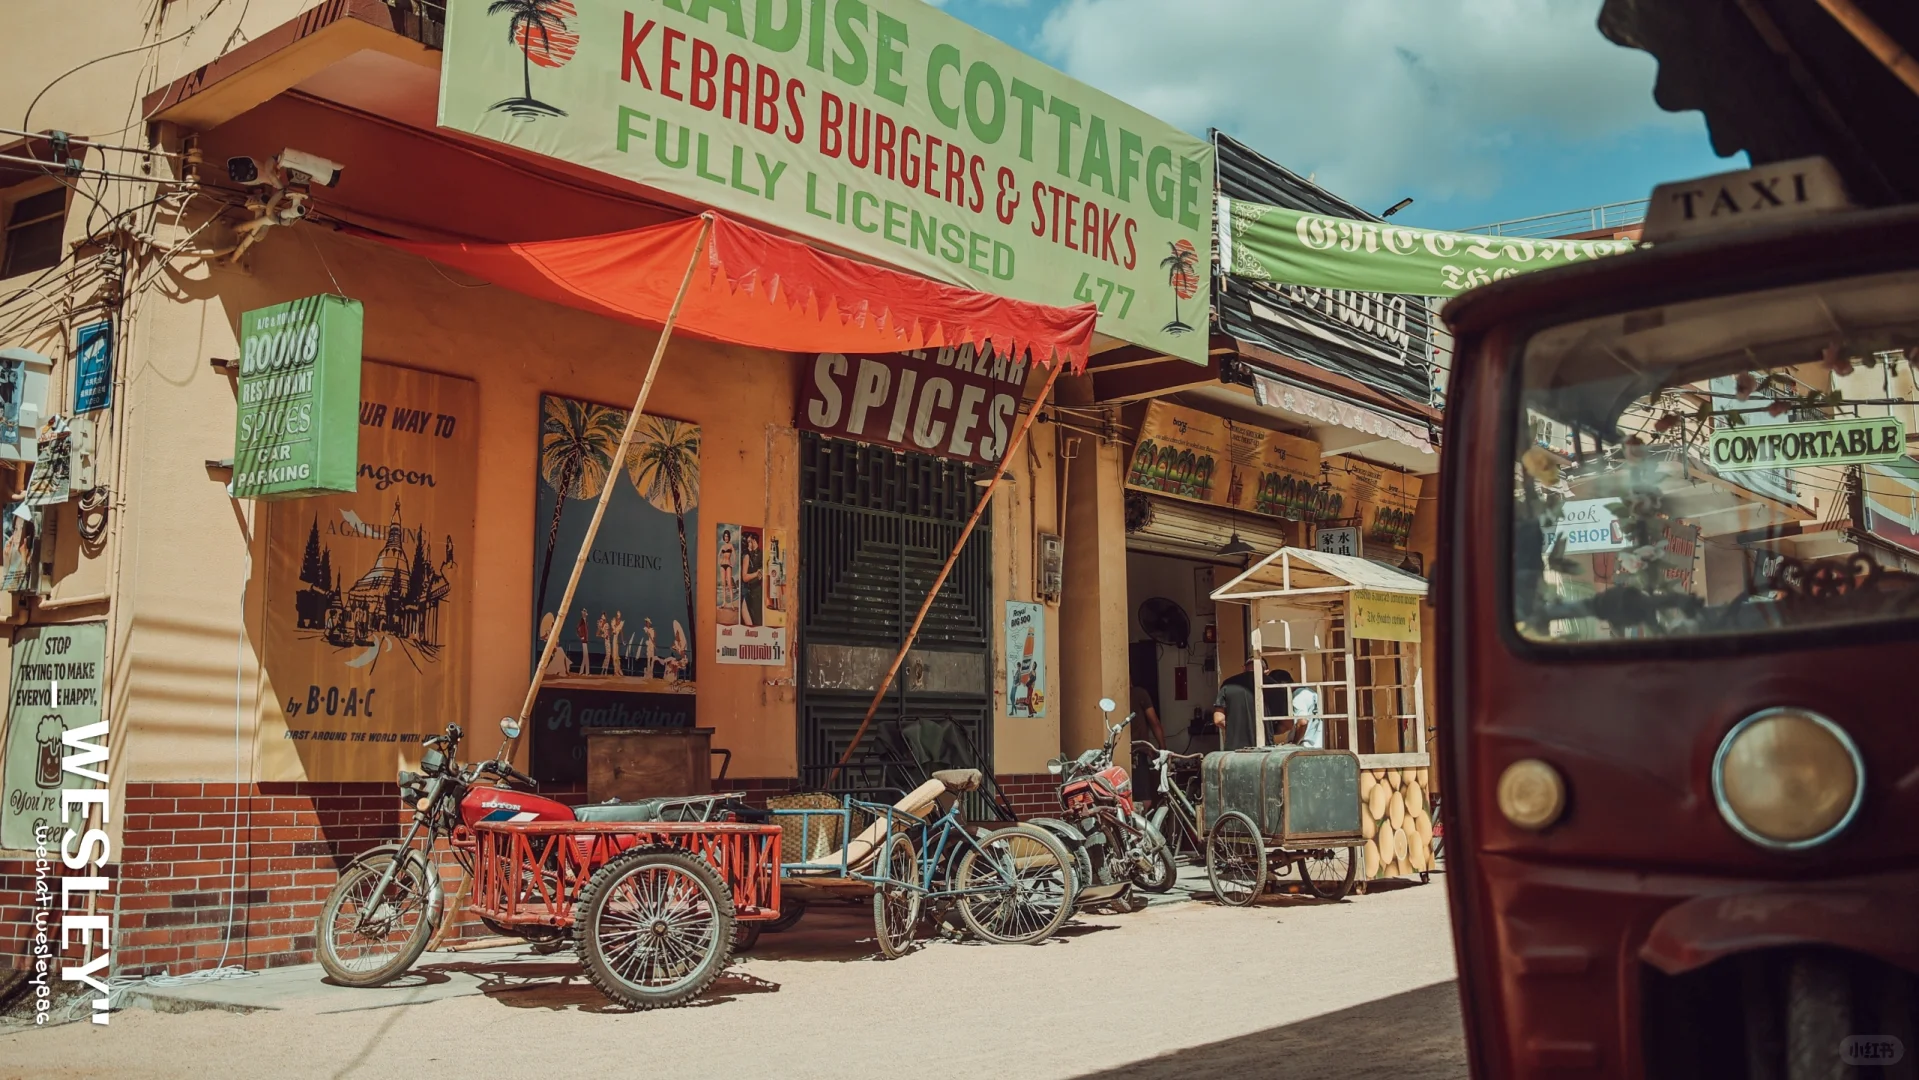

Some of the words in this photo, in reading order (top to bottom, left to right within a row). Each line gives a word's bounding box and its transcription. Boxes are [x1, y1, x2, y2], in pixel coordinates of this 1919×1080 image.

[621, 10, 806, 144] KEBABS
[820, 91, 986, 214] BURGERS
[996, 166, 1020, 225] &
[1031, 180, 1138, 271] STEAKS
[926, 43, 1202, 232] COTTAFGE
[616, 105, 788, 201] FULLY
[806, 171, 1016, 281] LICENSED
[1672, 172, 1810, 221] TAXI
[1073, 272, 1136, 320] 477
[242, 321, 320, 374] ROOMS
[243, 370, 314, 404] RESTAURANT
[807, 353, 1016, 462] SPICES
[241, 402, 313, 448] SPICES
[391, 406, 433, 435] WAY
[434, 413, 456, 439] TO
[258, 445, 292, 463] CAR
[1713, 426, 1900, 465] COMFORTABLE
[237, 463, 310, 488] PARKING
[357, 463, 437, 491] ngoon
[1557, 505, 1600, 523] ook
[1569, 528, 1610, 544] SHOP
[592, 549, 662, 571] GATHERING
[44, 636, 71, 655] STOP
[20, 663, 52, 681] TRYING
[54, 663, 65, 680] TO
[67, 662, 96, 679] MAKE
[16, 687, 62, 706] EVERYOE
[286, 697, 303, 717] by
[547, 698, 572, 731] A
[284, 730, 310, 741] FIRST
[311, 731, 347, 742] AROUND
[350, 732, 366, 742] THE
[368, 732, 397, 743] WORLD
[400, 733, 421, 744] WITH
[10, 788, 56, 816] You're
[481, 801, 521, 811] HOTON
